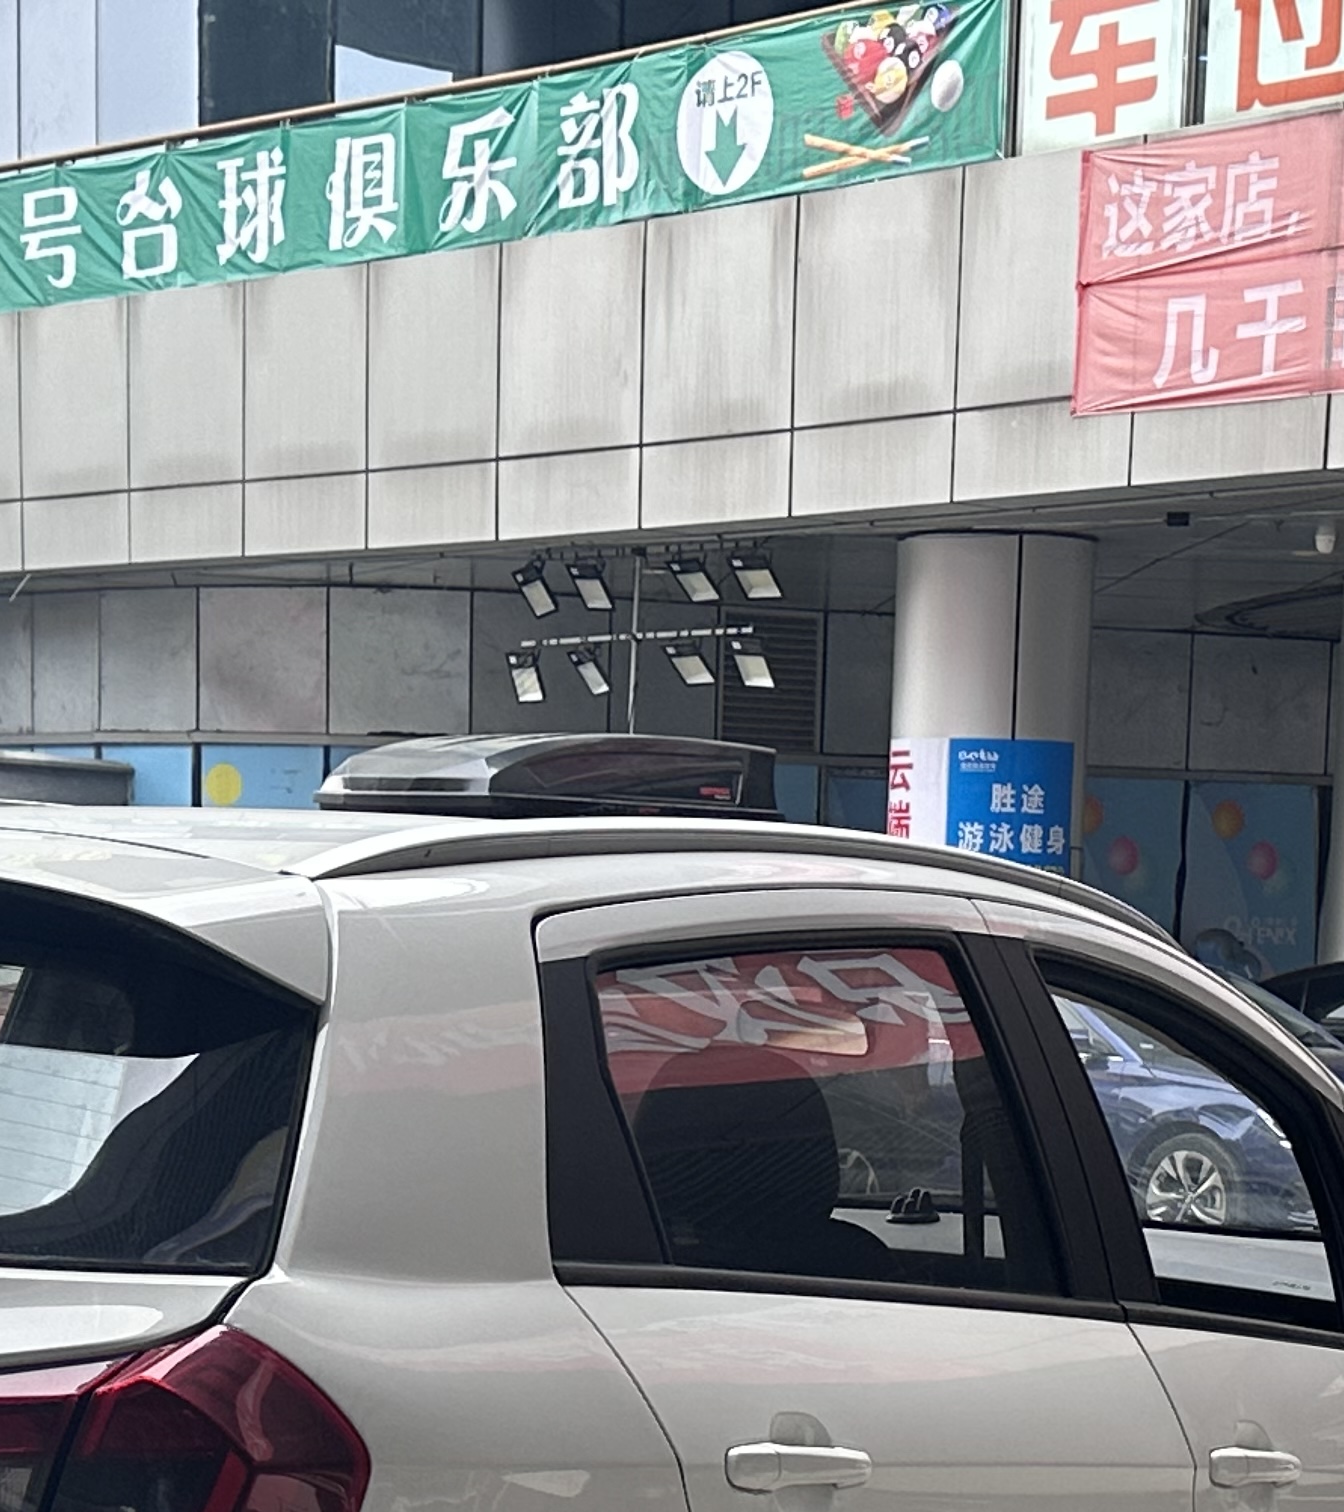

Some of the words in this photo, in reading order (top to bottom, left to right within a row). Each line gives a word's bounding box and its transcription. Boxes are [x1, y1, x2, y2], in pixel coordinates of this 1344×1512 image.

[695, 70, 763, 108] 请上2F
[989, 782, 1046, 815] 胜途
[958, 821, 1066, 856] 游泳健身
